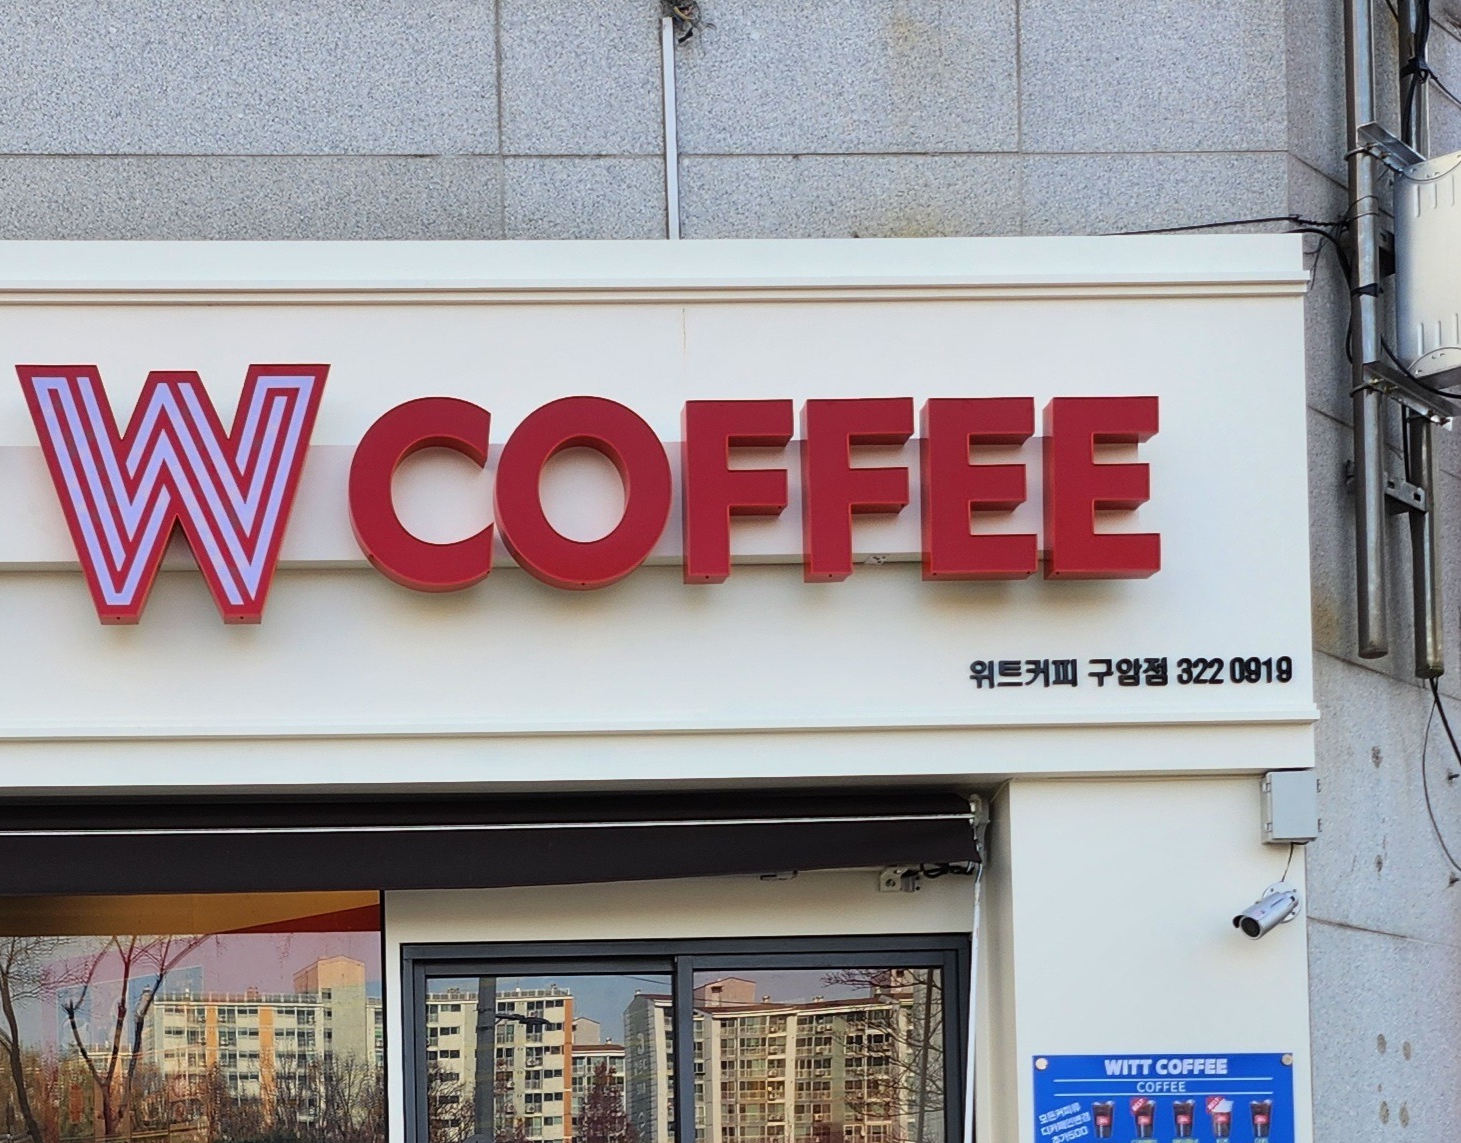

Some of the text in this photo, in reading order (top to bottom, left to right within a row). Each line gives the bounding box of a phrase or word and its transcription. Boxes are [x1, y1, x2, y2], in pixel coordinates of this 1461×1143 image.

[15, 363, 330, 625] W
[348, 396, 1161, 593] COFFEE
[969, 656, 1294, 690] 위트커피 구암점 322 0919
[1104, 1058, 1228, 1075] WITT COFFEE
[1136, 1081, 1187, 1093] COFFEE
